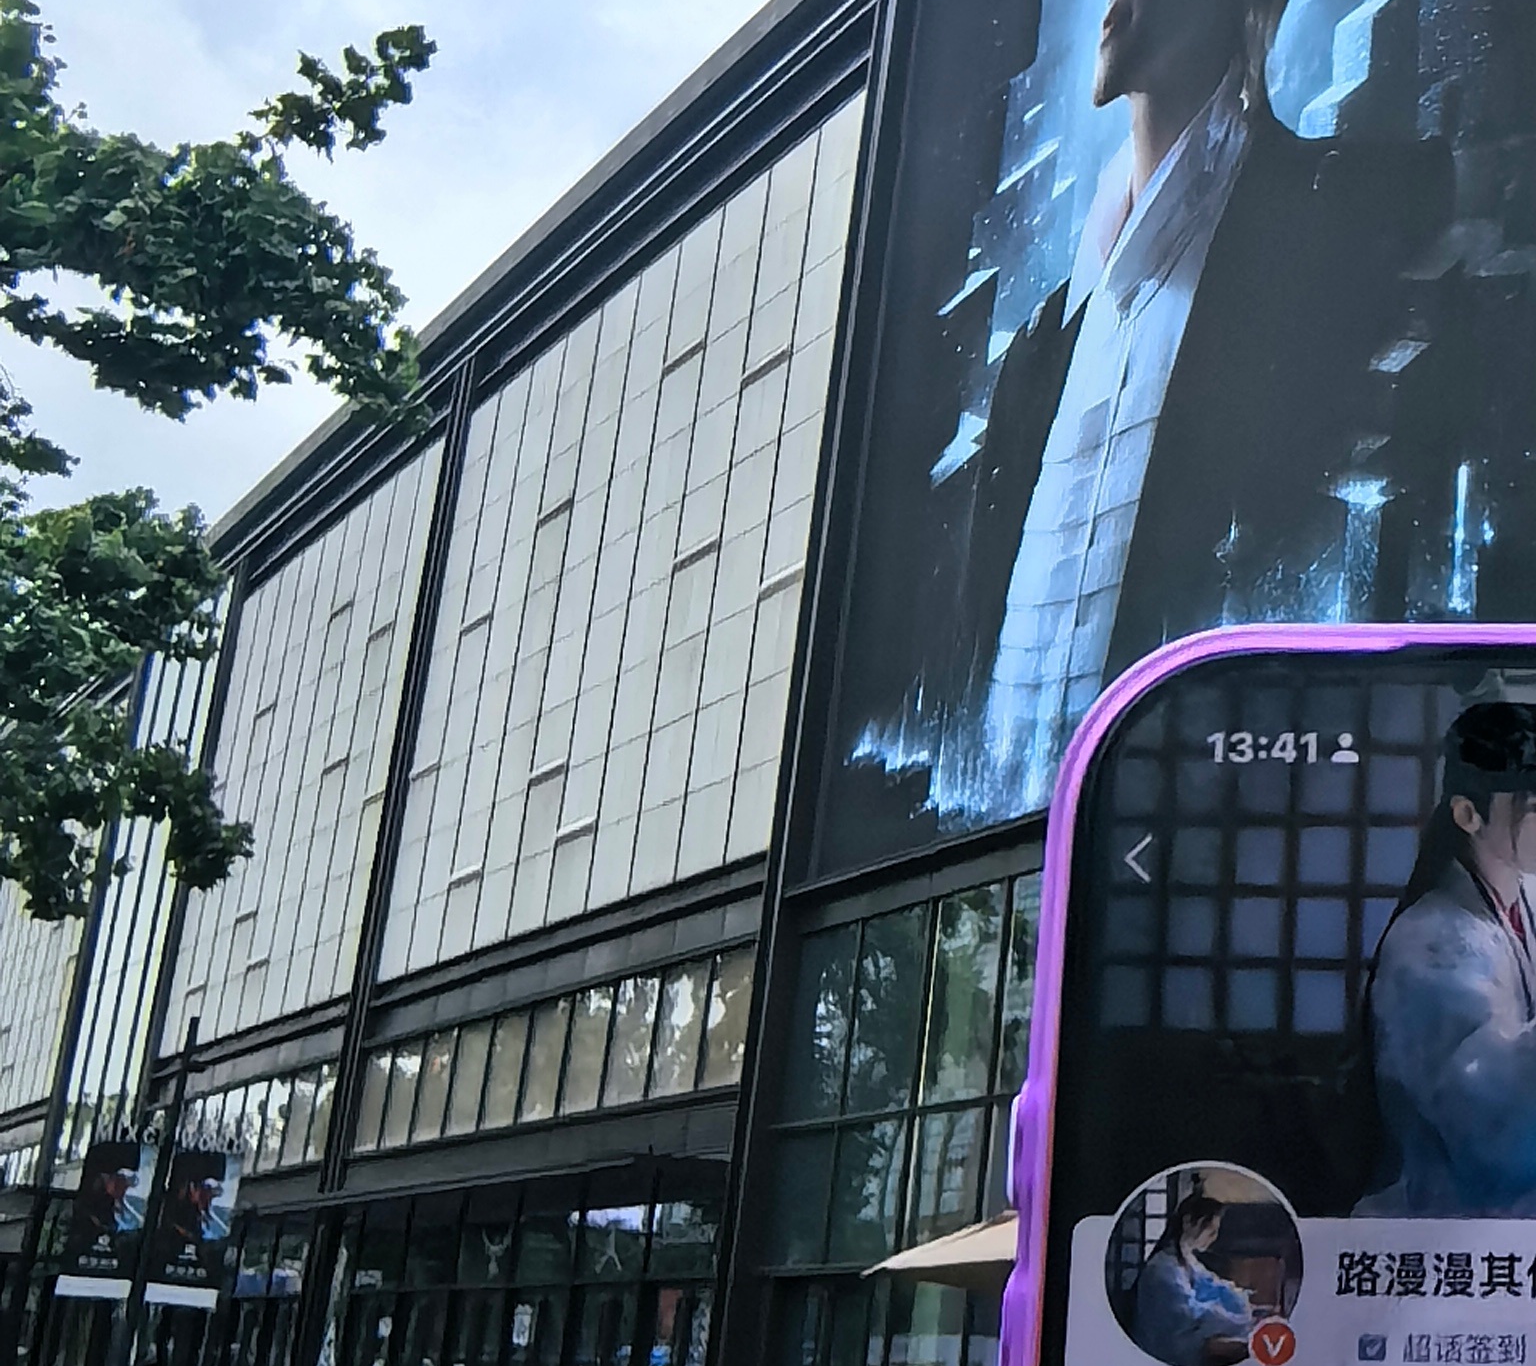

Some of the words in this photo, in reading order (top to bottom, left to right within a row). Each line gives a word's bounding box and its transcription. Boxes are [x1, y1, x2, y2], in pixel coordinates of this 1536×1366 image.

[1206, 730, 1321, 768] 13:41
[1402, 1333, 1528, 1366] 超话签到
